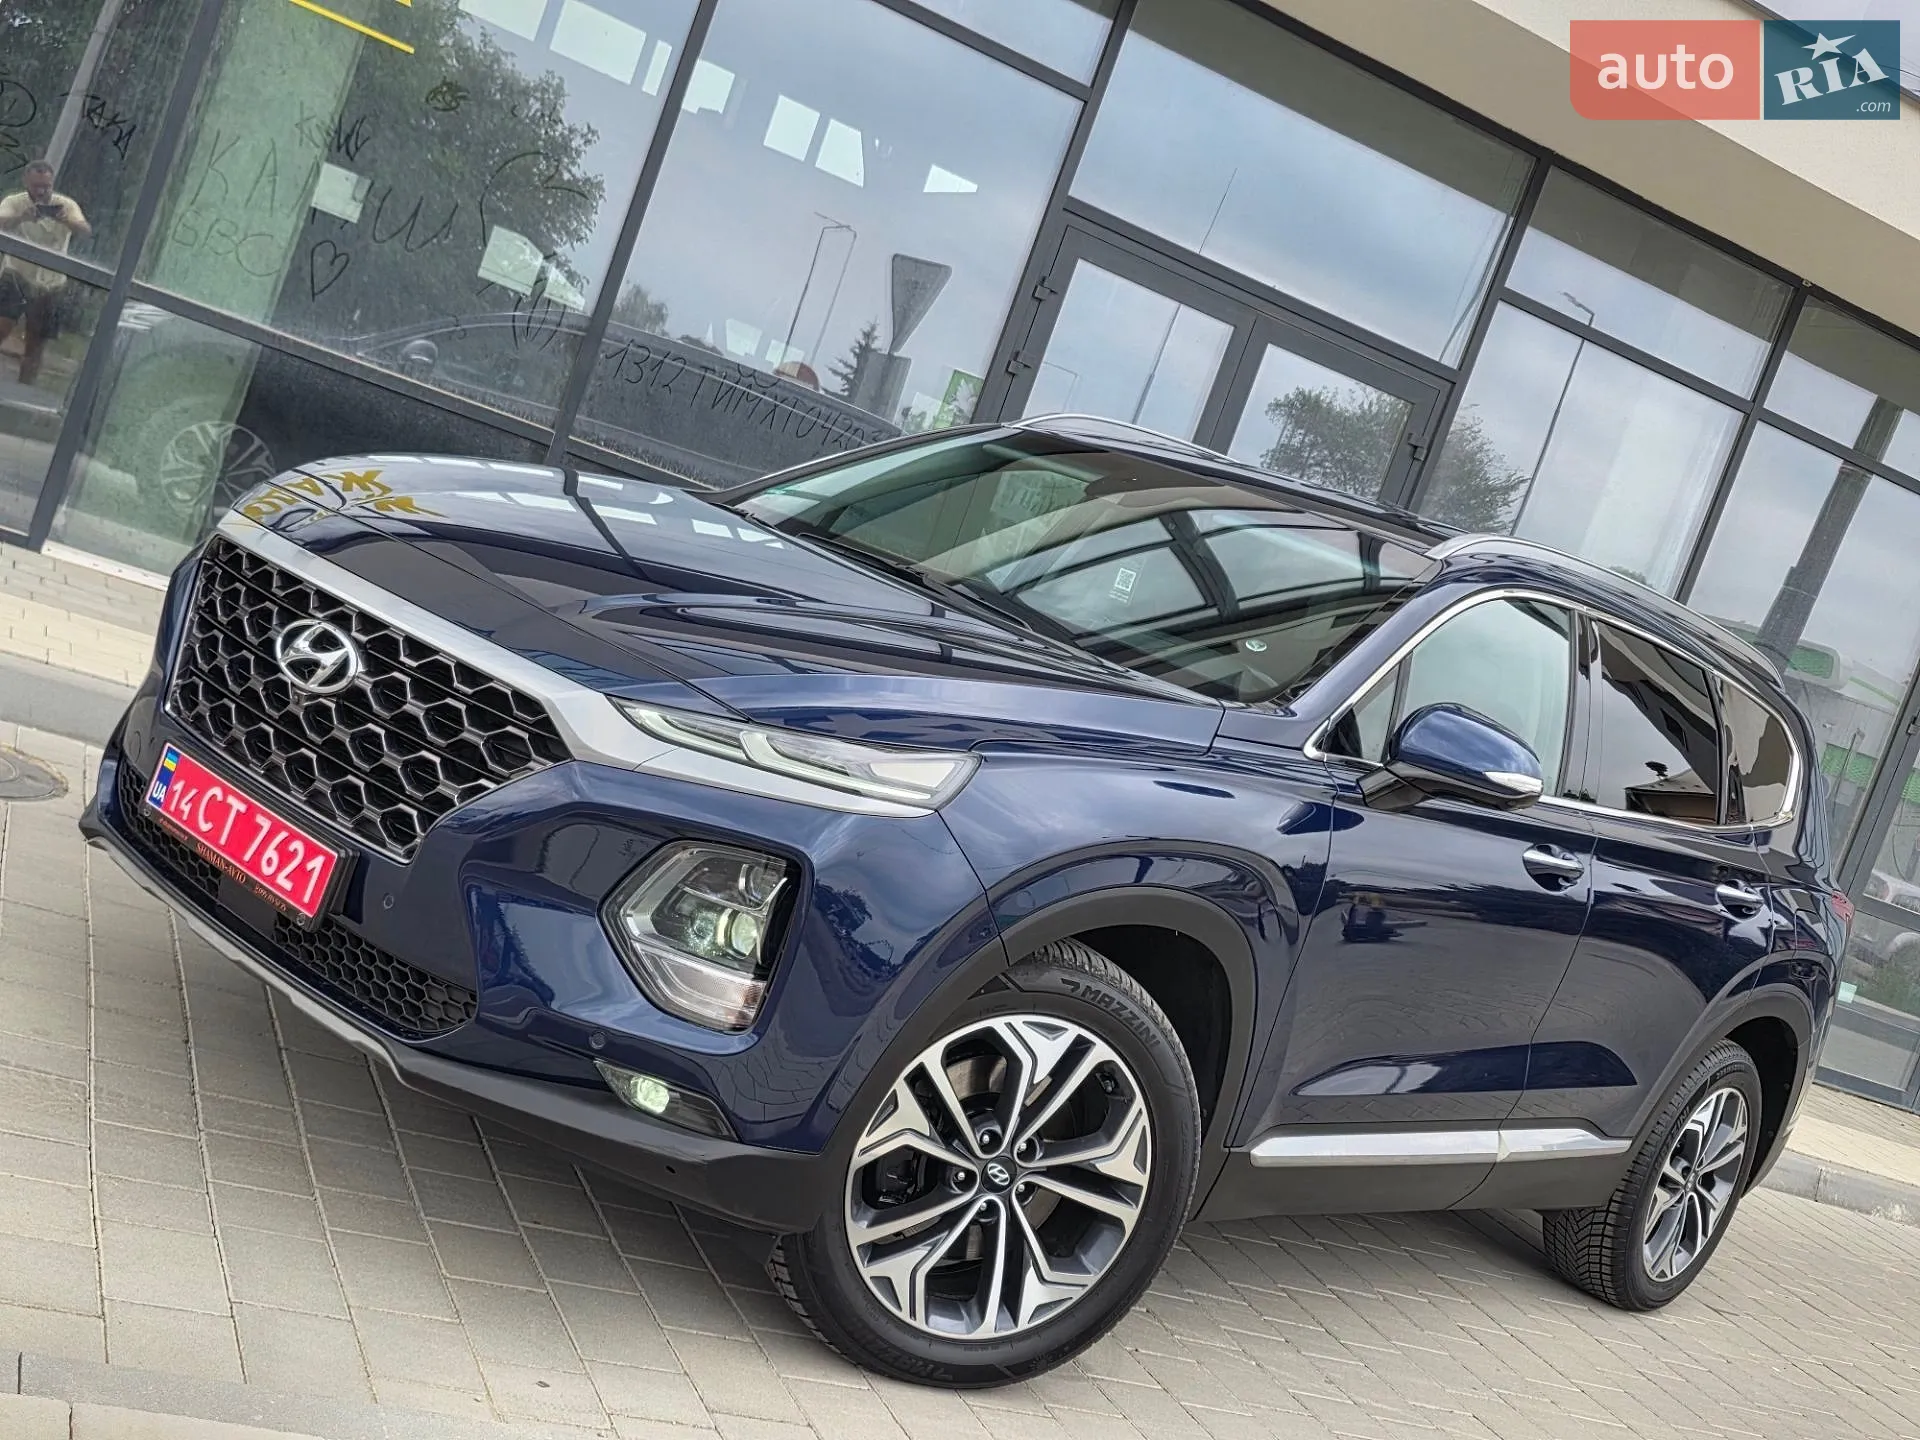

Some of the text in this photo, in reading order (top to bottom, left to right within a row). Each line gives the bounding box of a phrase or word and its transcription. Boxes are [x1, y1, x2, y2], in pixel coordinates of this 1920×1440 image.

[605, 338, 687, 395] 1312
[152, 781, 166, 803] UA
[243, 812, 326, 904] 7621
[1080, 984, 1162, 1048] MAZZINI
